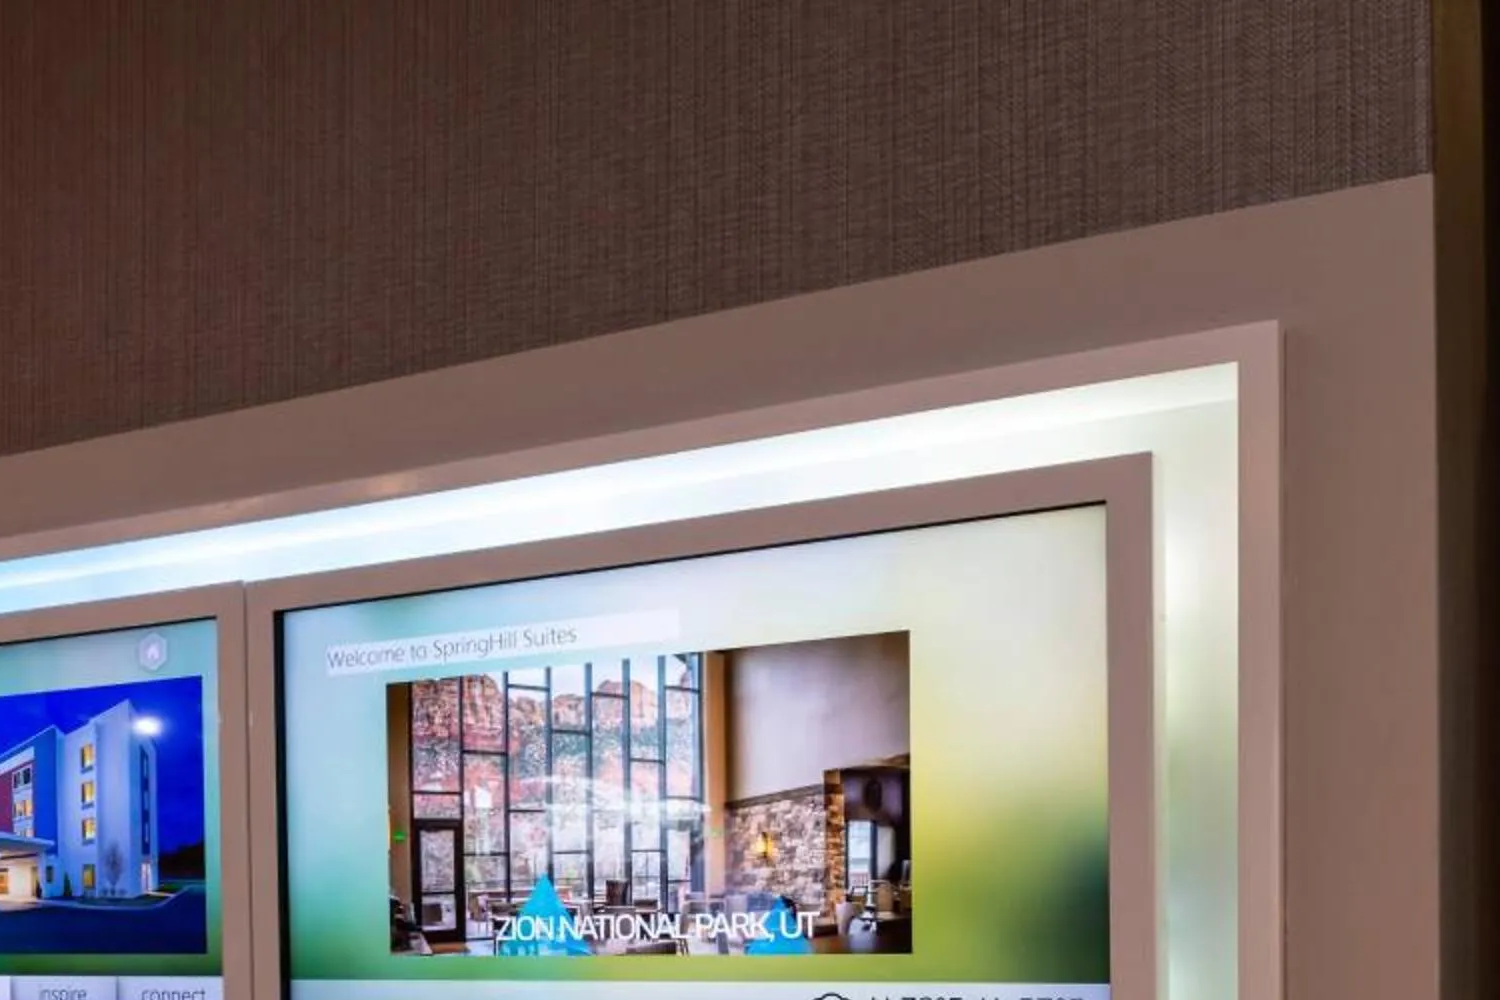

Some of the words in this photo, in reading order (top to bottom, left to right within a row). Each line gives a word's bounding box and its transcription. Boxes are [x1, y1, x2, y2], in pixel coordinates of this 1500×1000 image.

[327, 646, 405, 669] Welcome
[411, 643, 428, 660] to
[433, 633, 518, 664] SpringHill
[524, 627, 577, 648] Suites
[497, 914, 551, 941] ZION
[559, 912, 691, 940] NATIONAL
[698, 911, 775, 943] PARK,
[781, 909, 820, 938] UT
